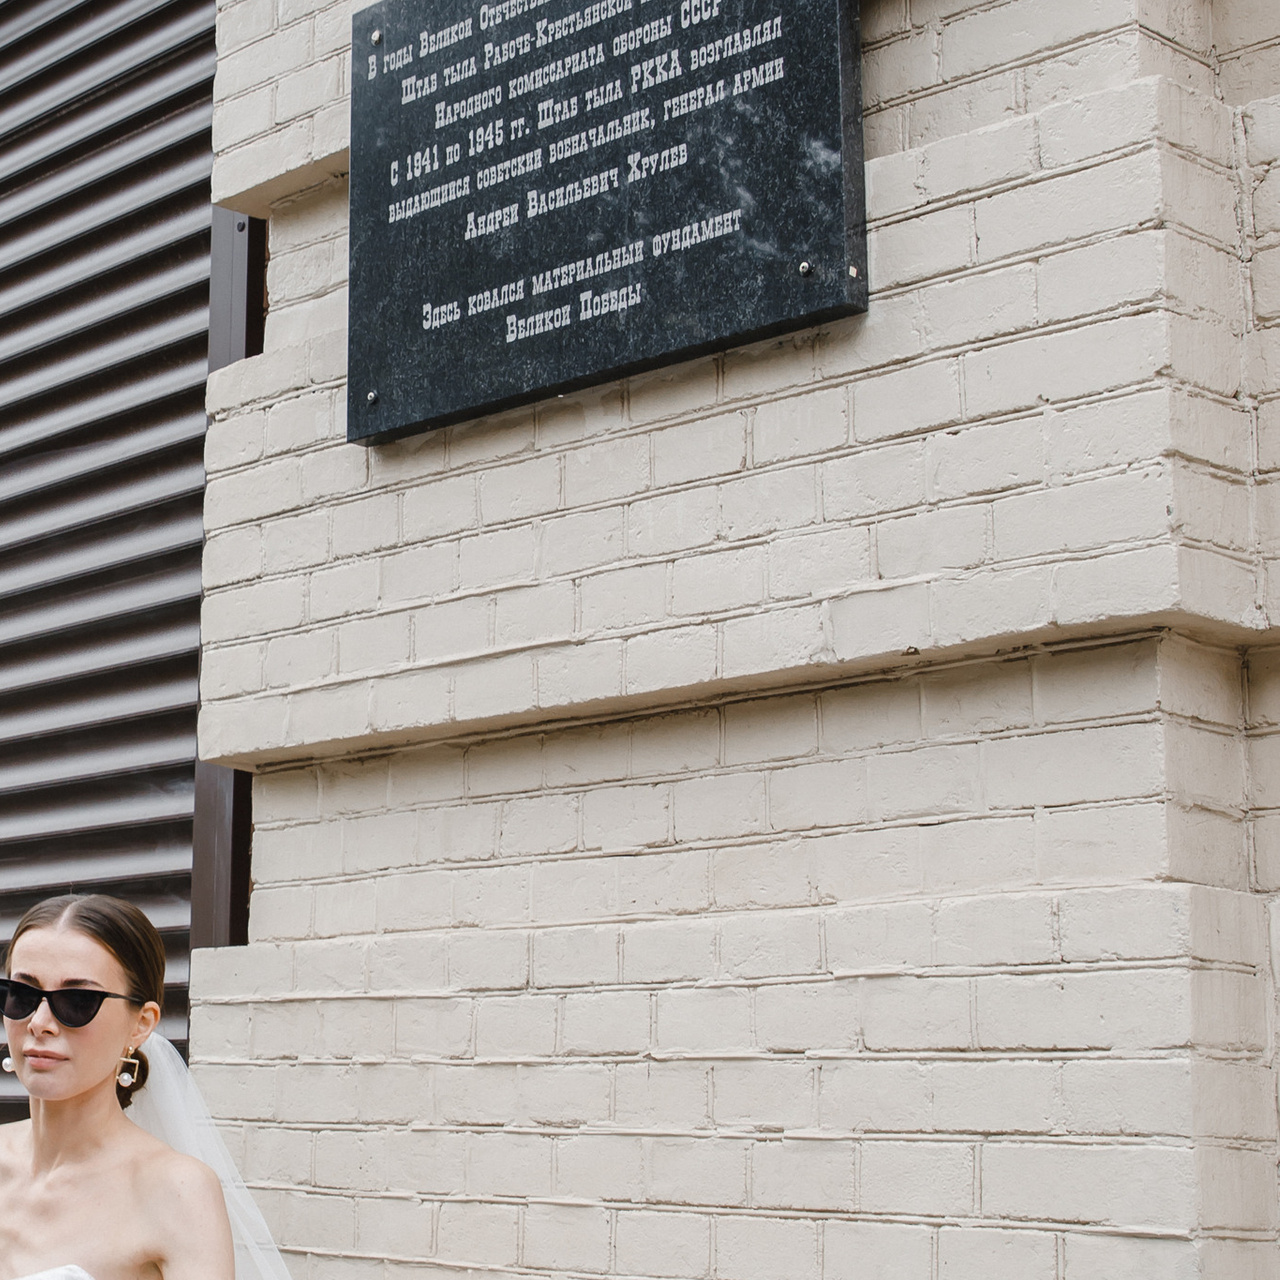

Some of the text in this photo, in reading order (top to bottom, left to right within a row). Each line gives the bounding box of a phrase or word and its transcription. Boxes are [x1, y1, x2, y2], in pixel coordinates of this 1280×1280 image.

[367, 54, 378, 81] В
[390, 159, 399, 187] С
[406, 144, 439, 181] 1941
[468, 118, 504, 157] 1945
[631, 48, 683, 94] РККА
